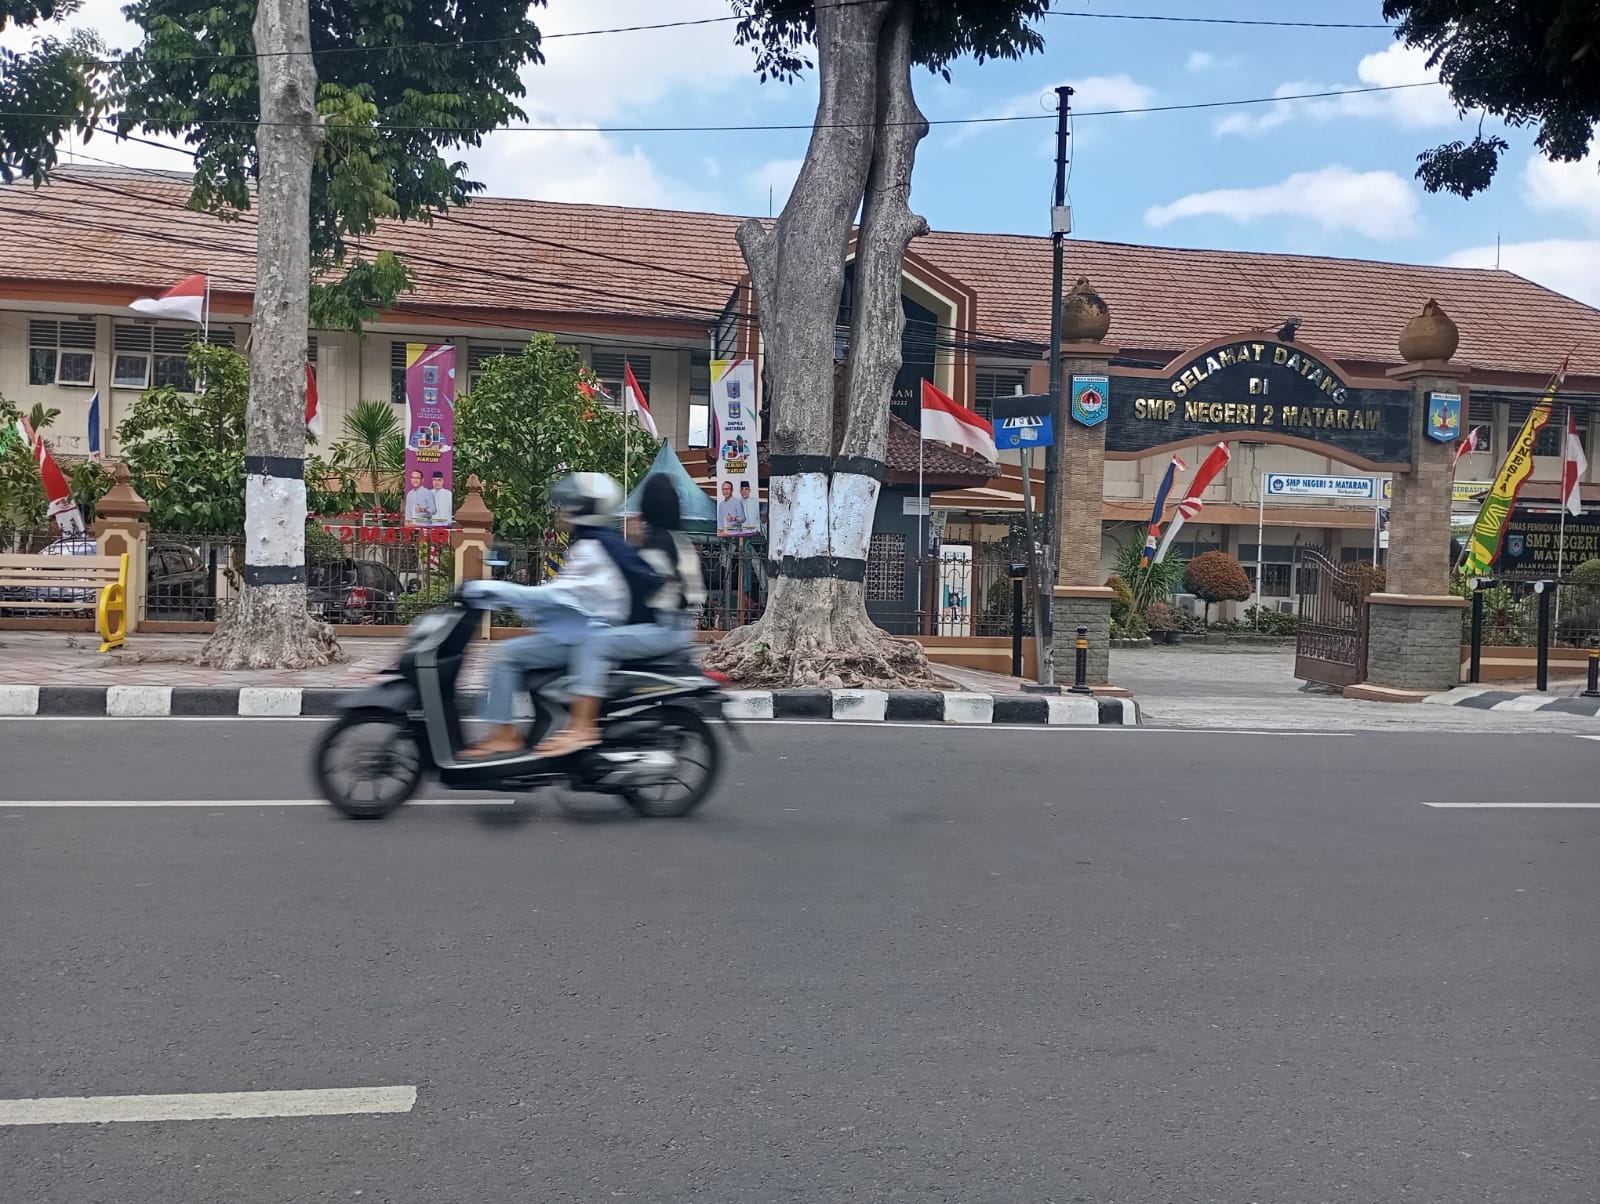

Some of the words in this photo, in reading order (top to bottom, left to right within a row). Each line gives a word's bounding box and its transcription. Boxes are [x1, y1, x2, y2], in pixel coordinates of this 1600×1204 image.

[1170, 343, 1264, 398] SELAMAT
[1273, 346, 1349, 405] DATANG
[1249, 377, 1269, 395] DI
[1134, 398, 1176, 421] SMP
[1184, 401, 1257, 425] NEGERI
[1262, 407, 1274, 425] 2
[1282, 405, 1381, 430] MATARAM
[1286, 478, 1301, 487] SMP
[1302, 479, 1327, 488] NEGERI
[1335, 480, 1368, 489] MATARAM
[1508, 522, 1526, 531] DINAS
[1564, 524, 1579, 533] KOTA
[1526, 533, 1551, 548] SMP
[1553, 535, 1598, 550] NEGERI
[1534, 550, 1599, 562] MATARAM
